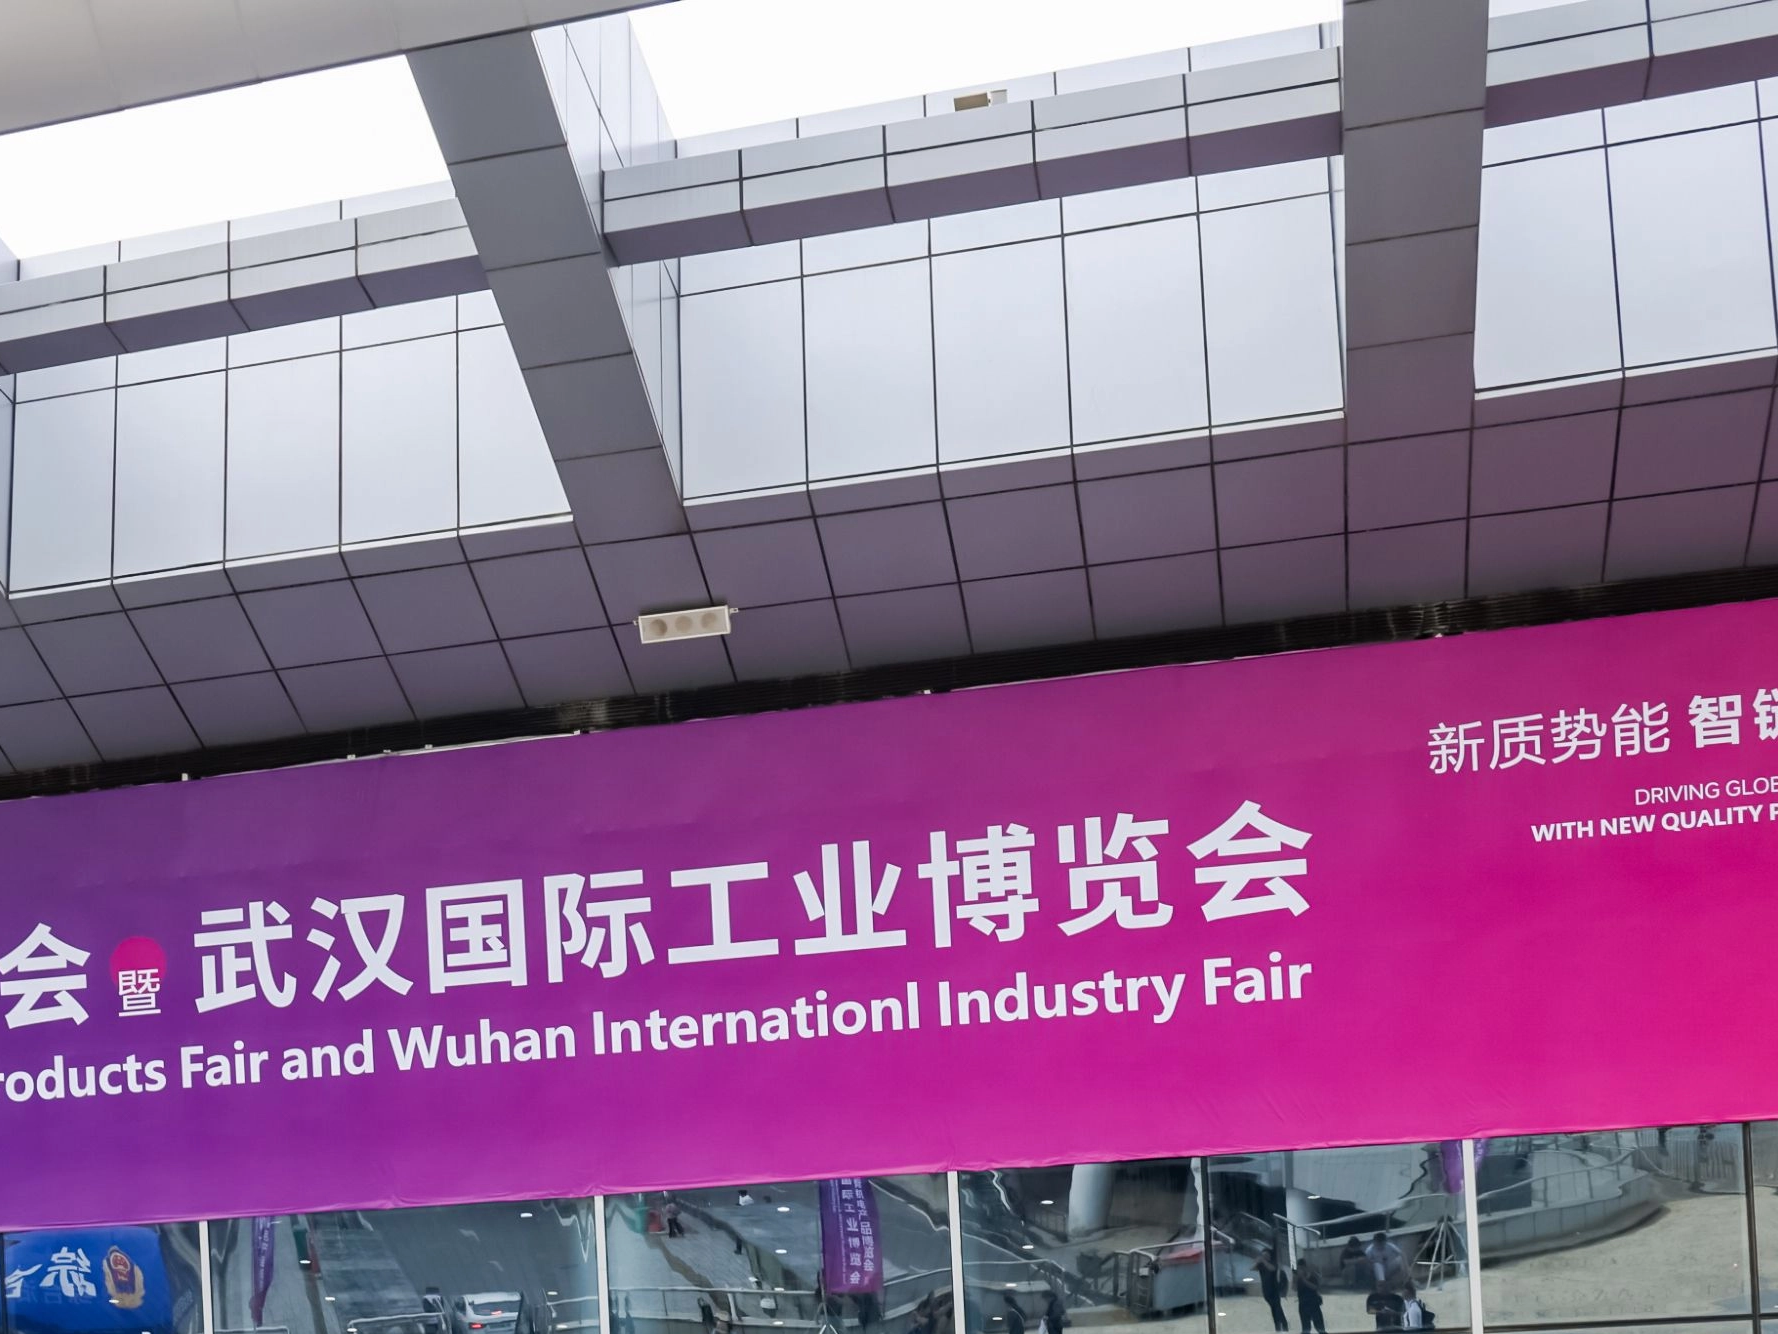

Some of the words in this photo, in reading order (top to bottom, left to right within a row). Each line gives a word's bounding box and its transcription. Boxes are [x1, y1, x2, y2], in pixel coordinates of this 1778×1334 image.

[1428, 701, 1671, 774] 新质势能
[1531, 820, 1594, 842] WITH
[1600, 815, 1656, 836] NEW
[1661, 804, 1763, 832] QUALITY
[1634, 781, 1720, 806] DRIVING
[117, 968, 161, 1017] 暨
[194, 800, 1313, 1014] 武汉国际工业博览会
[179, 1040, 269, 1090] Fair
[280, 1028, 375, 1081] and
[387, 1018, 576, 1073] Wuhan
[592, 980, 920, 1055] Internationl
[938, 969, 1186, 1026] Industry
[1203, 951, 1313, 1006] Fair
